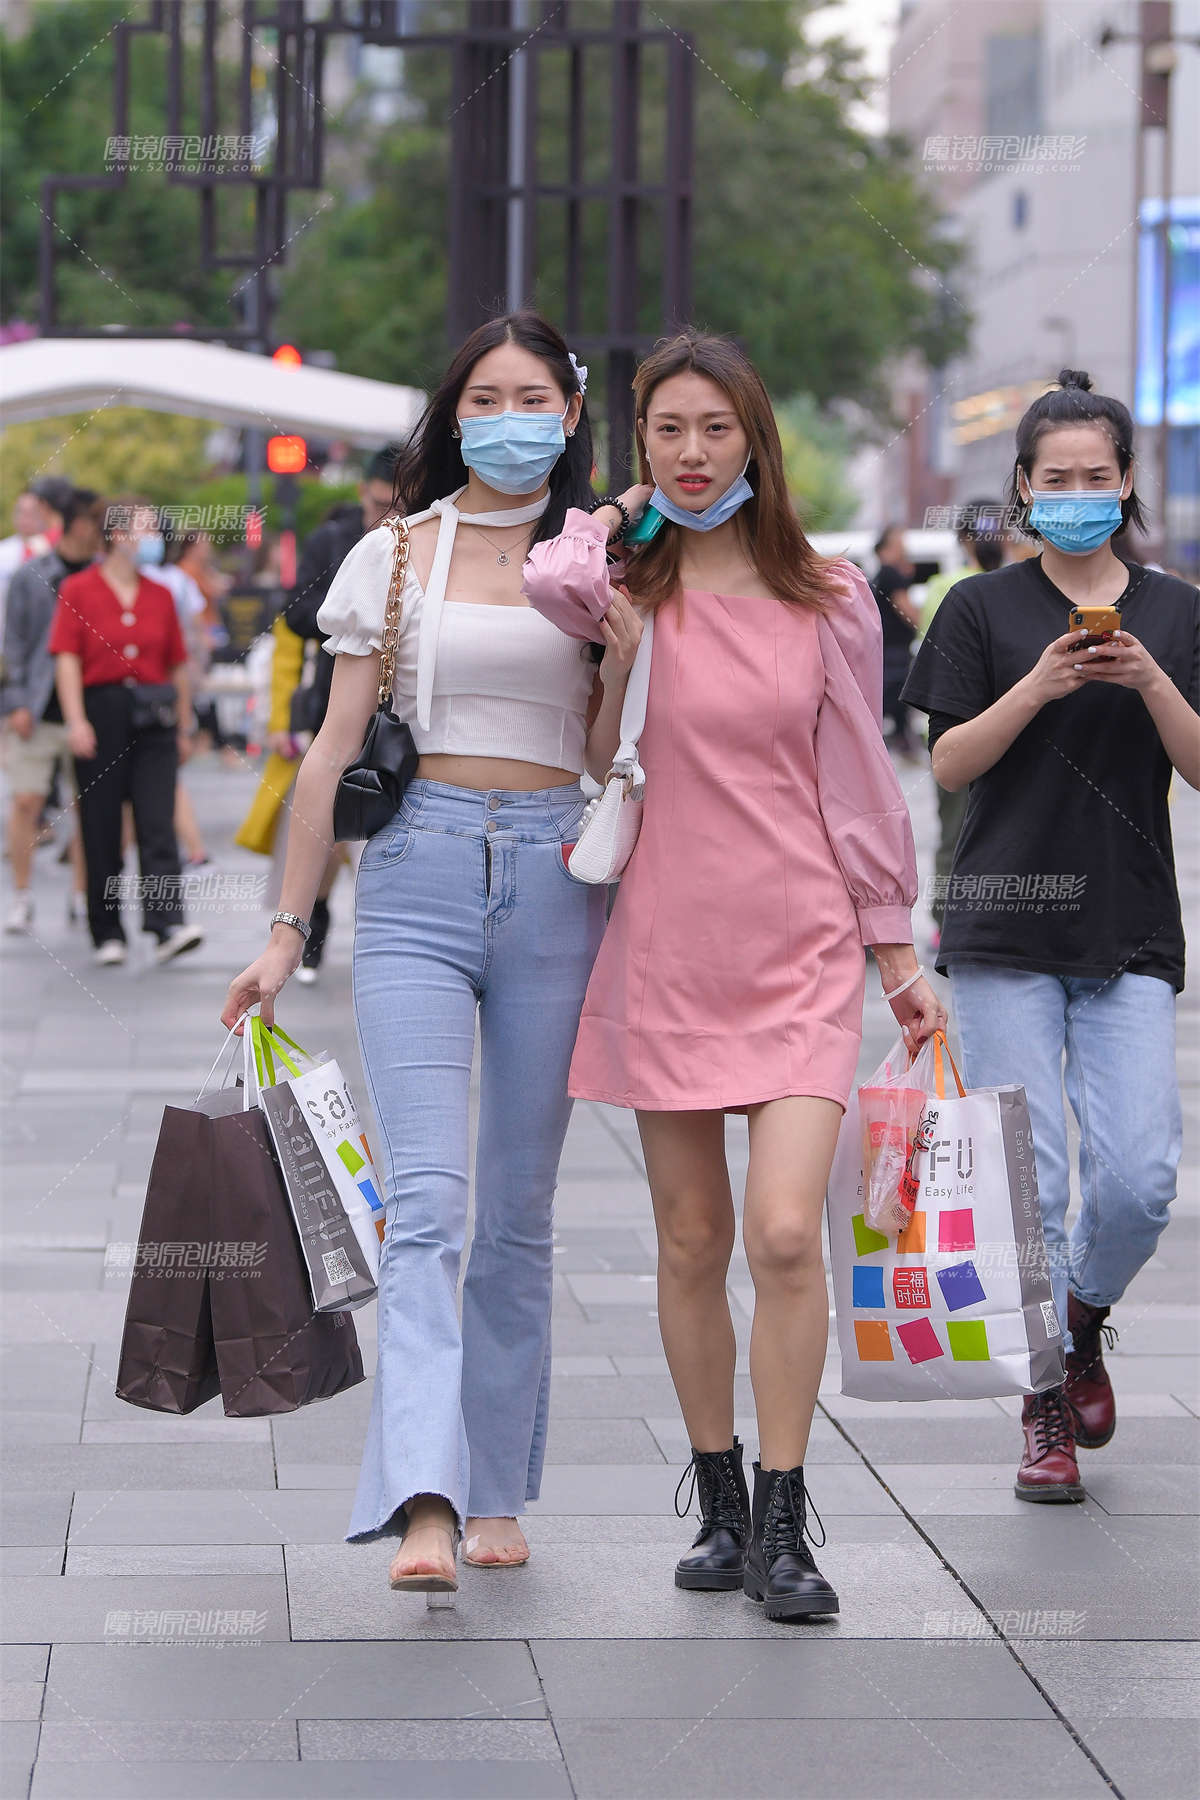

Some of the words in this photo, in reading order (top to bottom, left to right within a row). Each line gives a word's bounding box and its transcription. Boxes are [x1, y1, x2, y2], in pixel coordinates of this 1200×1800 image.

[1015, 1130, 1025, 1160] Easy
[1020, 1166, 1033, 1218] Fashion
[925, 1186, 953, 1199] Easy
[956, 1184, 975, 1195] Life
[895, 1271, 925, 1288] 三福
[897, 1288, 927, 1305] 时尚
